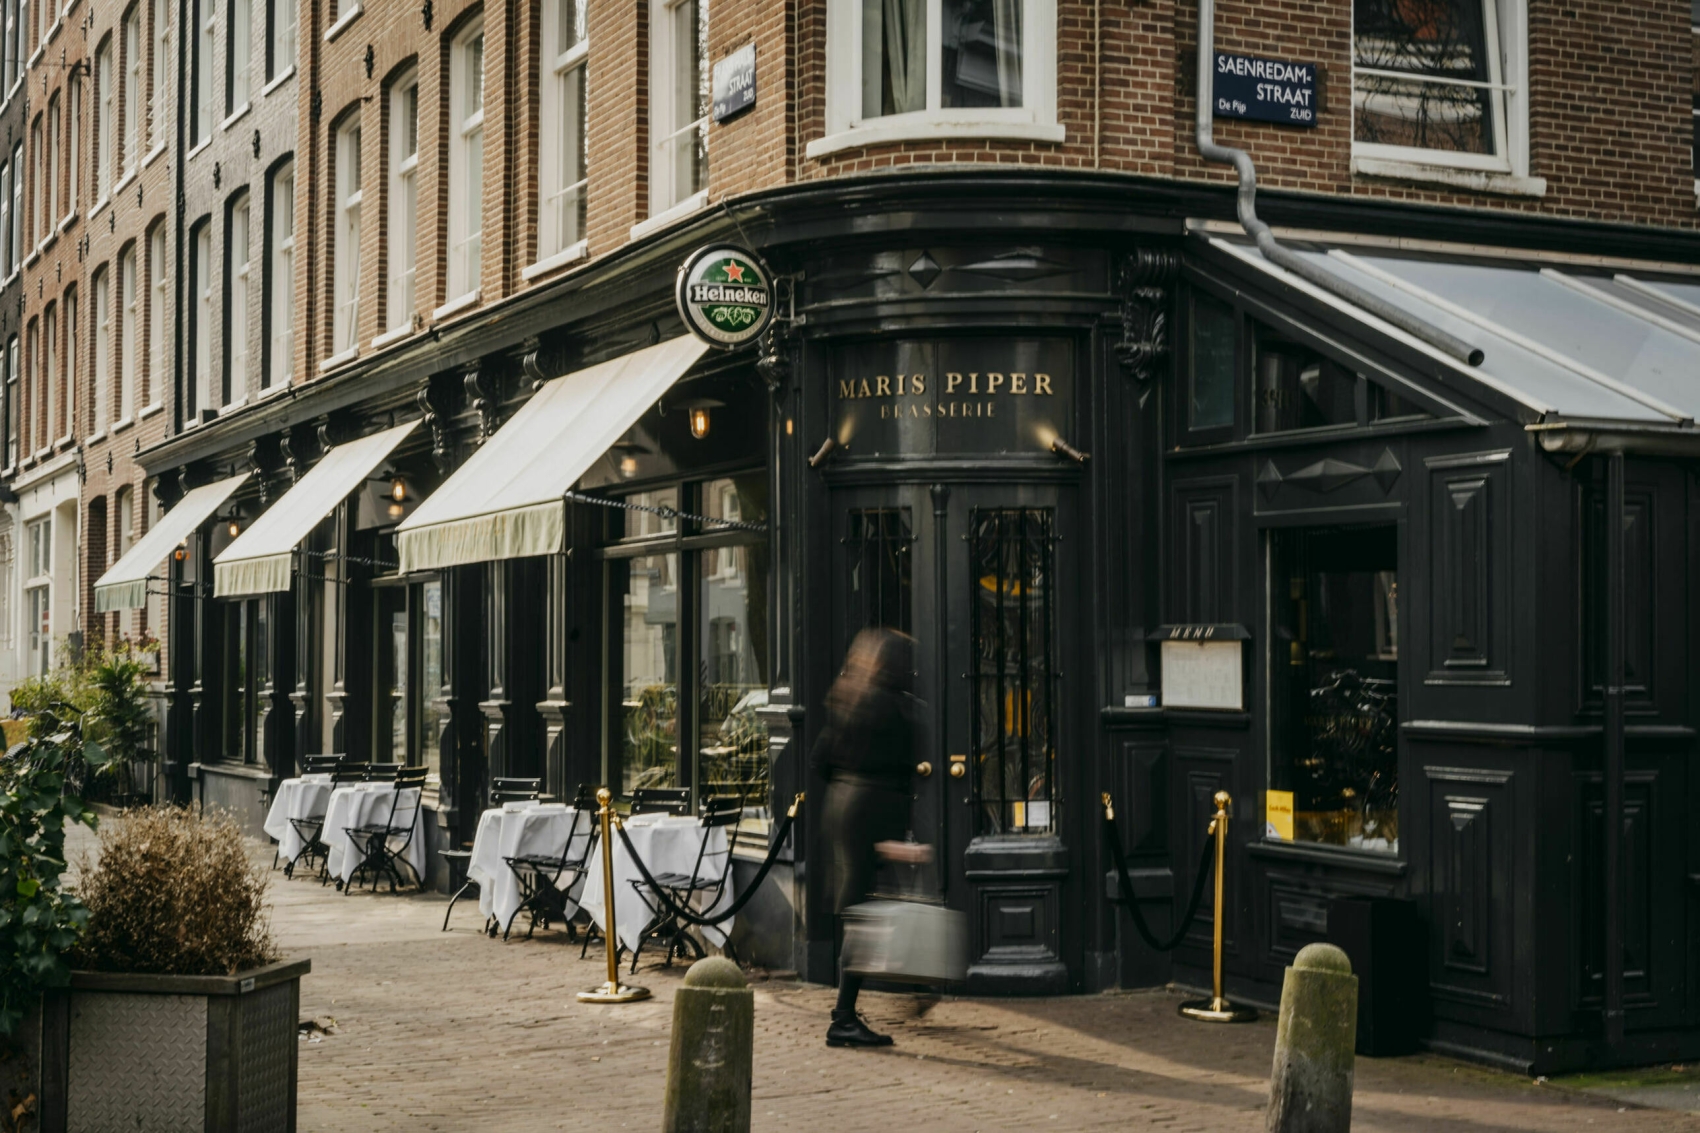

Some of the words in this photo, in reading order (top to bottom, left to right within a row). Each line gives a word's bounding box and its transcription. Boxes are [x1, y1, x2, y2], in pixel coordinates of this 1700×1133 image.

[729, 69, 753, 96] STRAAT
[1256, 83, 1312, 107] STRAAT
[1218, 98, 1231, 111] De
[1232, 99, 1247, 115] Pijp
[1290, 107, 1312, 121] ZUID
[694, 285, 767, 305] Heineken
[838, 373, 927, 399] MARIS
[945, 372, 1054, 395] PIPER
[881, 401, 996, 419] BRASSERIE
